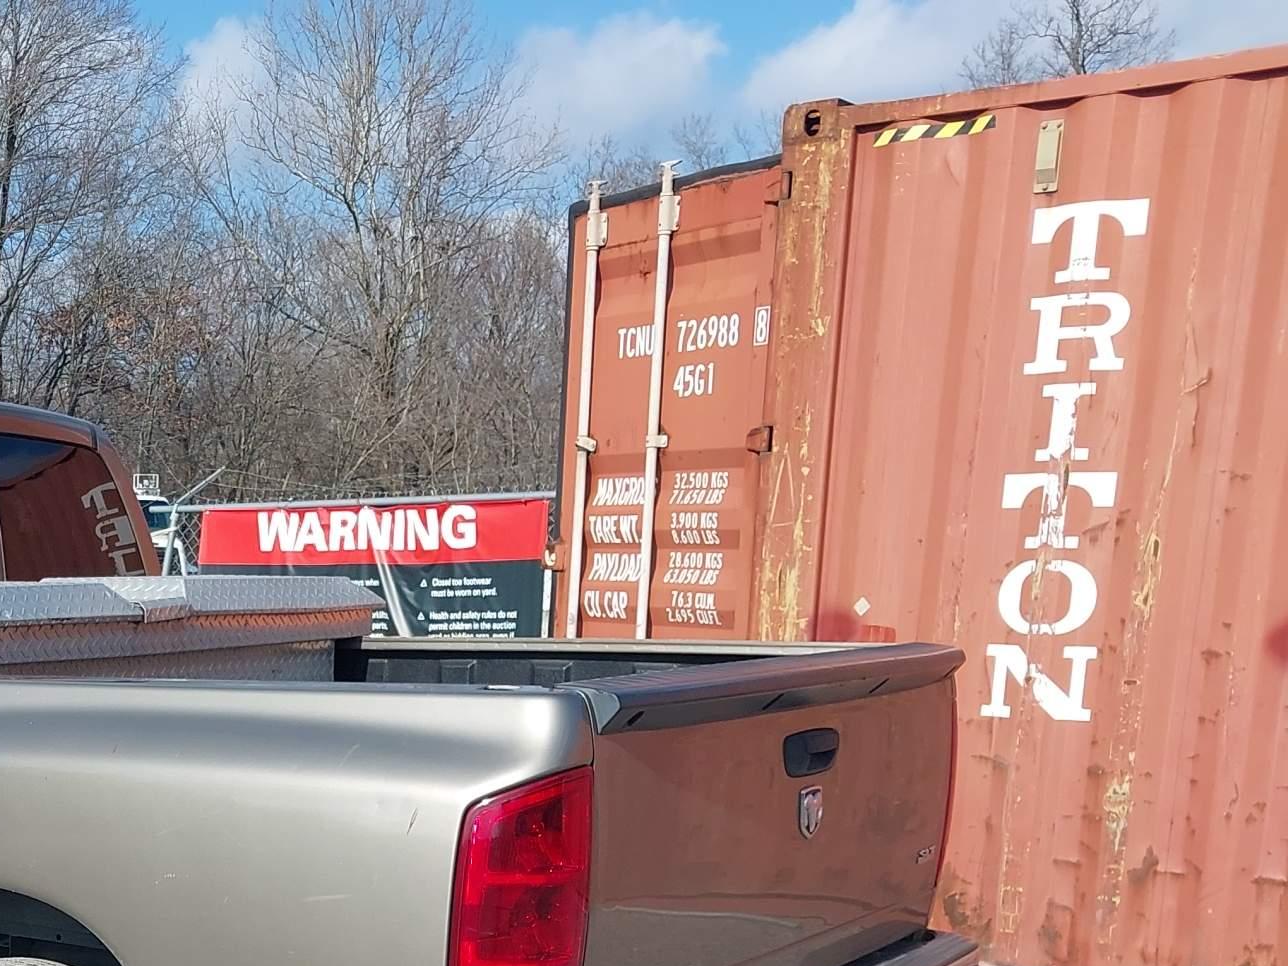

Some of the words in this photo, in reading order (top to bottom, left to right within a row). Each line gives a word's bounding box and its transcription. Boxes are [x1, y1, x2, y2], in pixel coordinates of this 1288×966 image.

[677, 313, 740, 352] 726988
[673, 362, 715, 397] 45G1
[980, 198, 1151, 722] TRITON
[674, 472, 709, 489] 32.500
[711, 472, 728, 488] KGS
[669, 489, 705, 505] 71.650
[706, 489, 725, 505] LBS
[257, 504, 478, 552] WARNING
[670, 512, 699, 529] 3.900
[700, 512, 718, 529] KGS
[589, 516, 620, 543] TARE
[672, 529, 701, 545] 8.600
[701, 529, 720, 545] LBS
[669, 551, 703, 568] 28.600
[705, 552, 723, 569] KGS
[432, 578, 452, 587] Closed
[452, 578, 463, 587] toe
[463, 576, 492, 586] footwear
[663, 568, 700, 584] 63.050
[699, 569, 720, 585] LBS
[431, 589, 446, 598] must
[447, 588, 455, 597] be
[455, 588, 472, 597] worn
[473, 588, 481, 596] on
[482, 587, 498, 598] yard.
[429, 610, 449, 620] Health
[449, 610, 462, 620] and
[462, 610, 481, 621] safety
[481, 610, 497, 619] rules
[498, 609, 506, 619] do
[506, 610, 518, 619] not
[665, 607, 695, 624] 2.695
[428, 622, 448, 632] permit
[448, 621, 472, 630] children
[472, 621, 479, 630] in
[480, 621, 491, 630] the
[492, 621, 517, 630] auction
